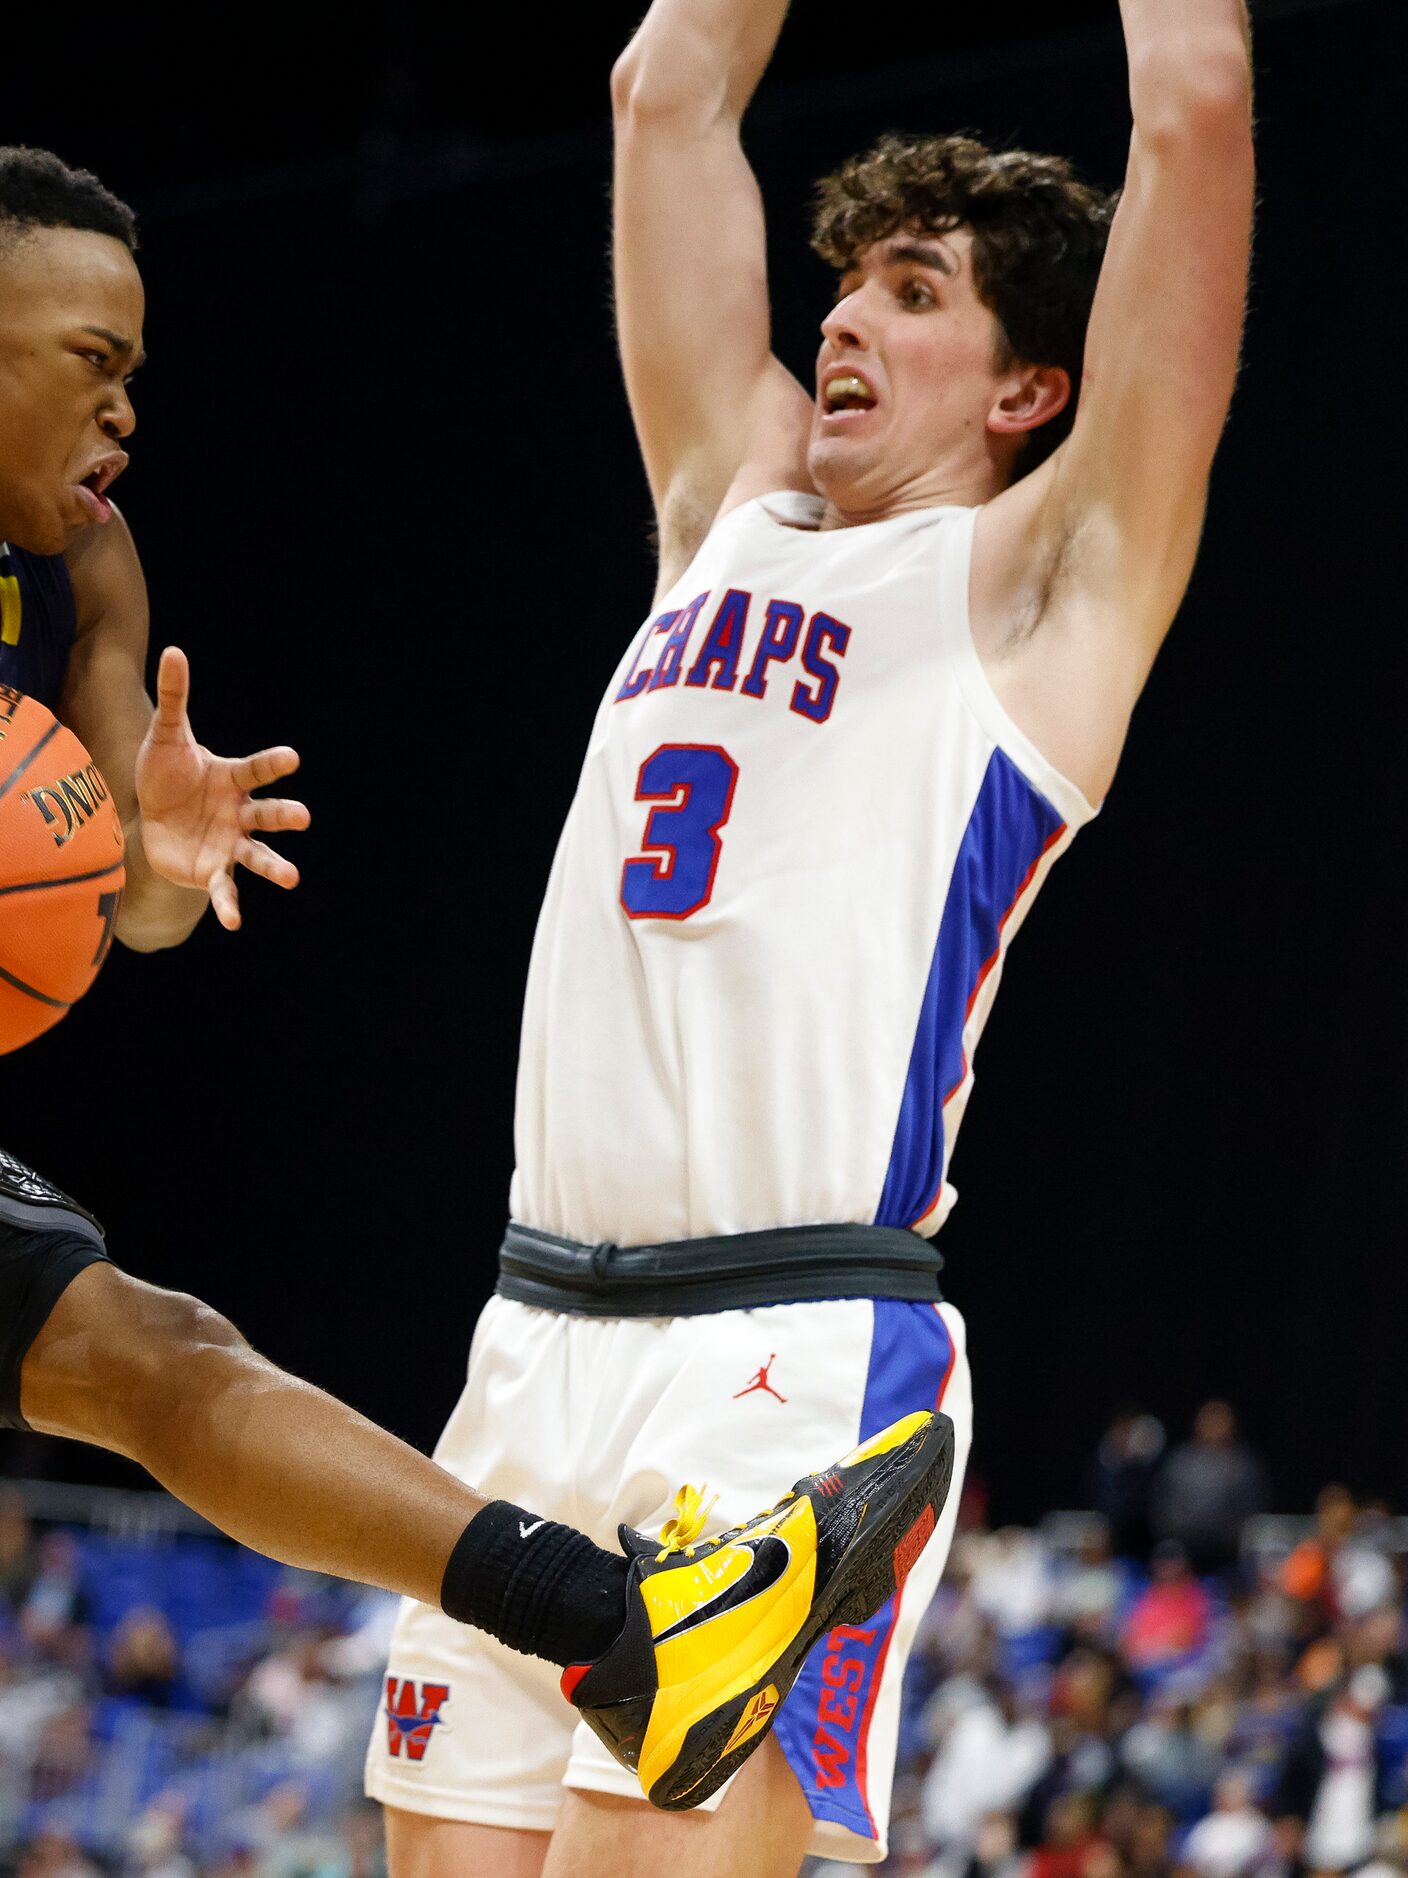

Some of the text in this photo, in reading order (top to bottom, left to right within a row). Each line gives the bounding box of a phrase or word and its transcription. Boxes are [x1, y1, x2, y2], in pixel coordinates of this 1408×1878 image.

[612, 588, 852, 724] CHAPS
[28, 760, 108, 848] DING
[619, 743, 740, 921] 3
[387, 1676, 450, 1762] W
